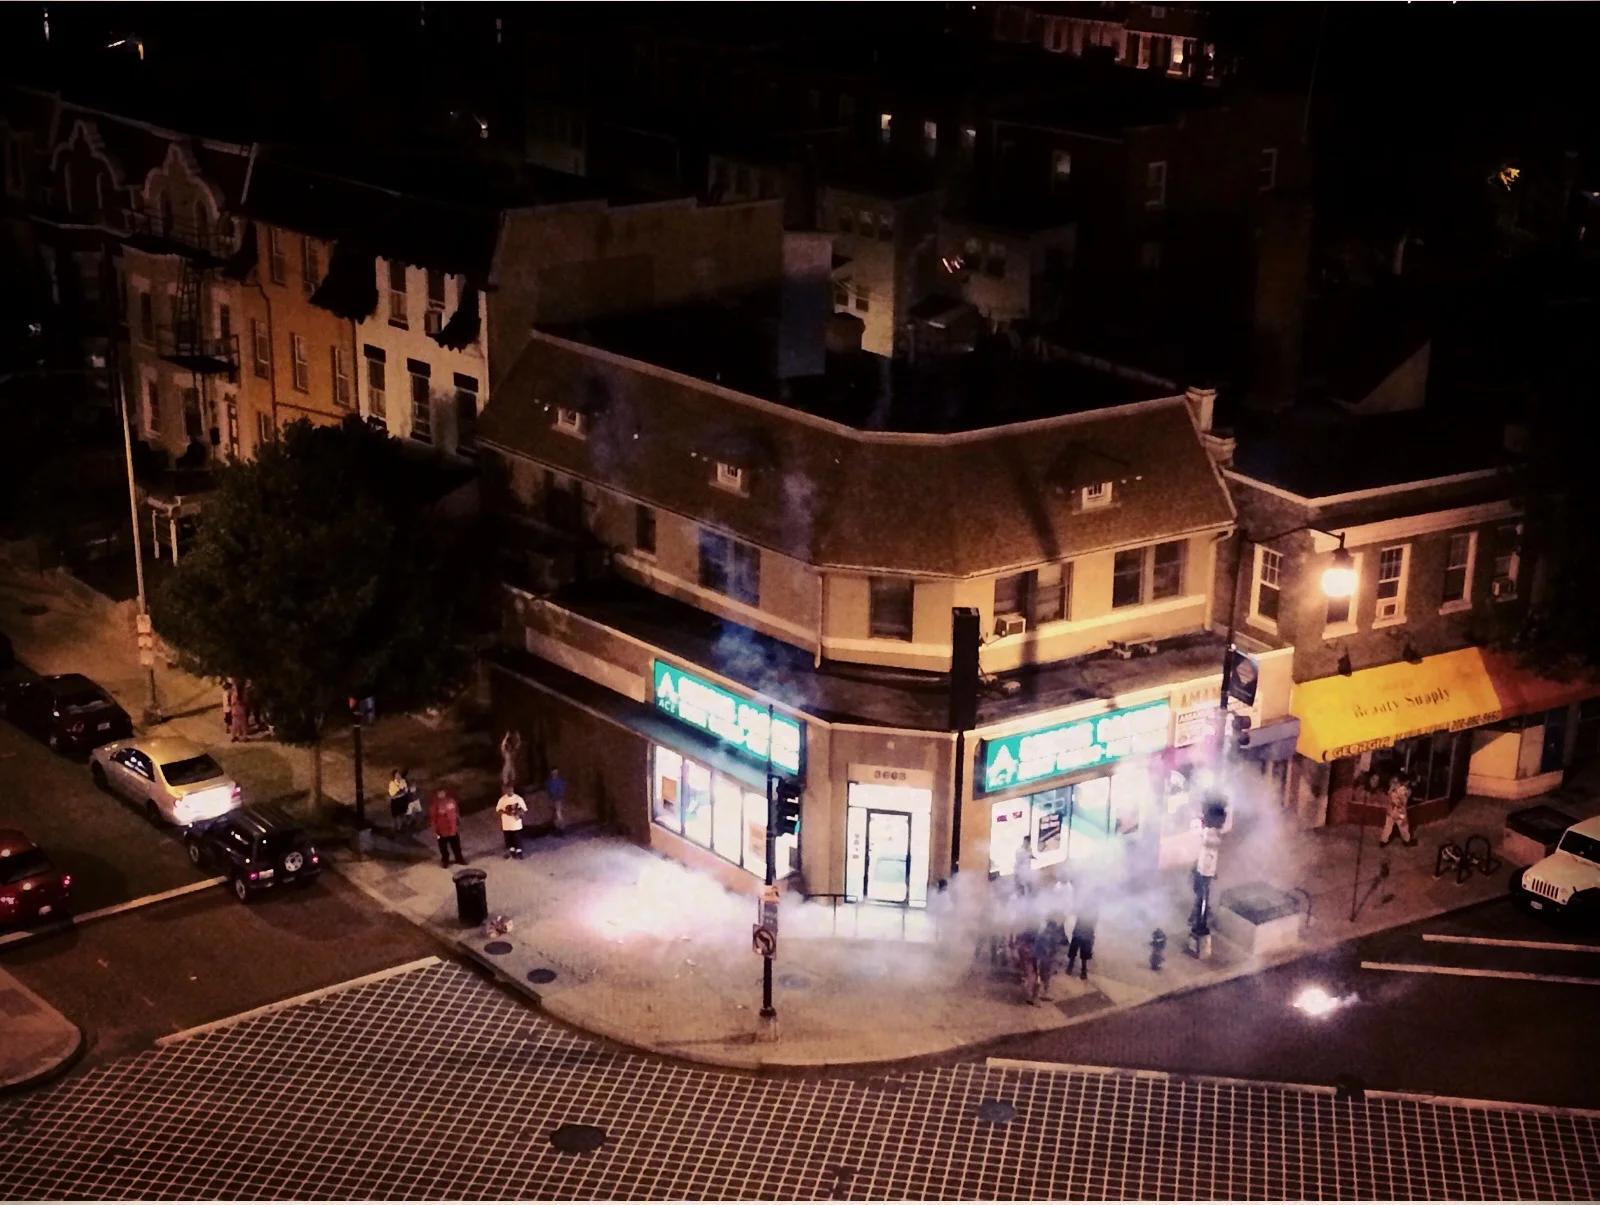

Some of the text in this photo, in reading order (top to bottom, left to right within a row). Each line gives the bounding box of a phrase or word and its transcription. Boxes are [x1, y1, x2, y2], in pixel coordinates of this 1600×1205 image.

[658, 699, 675, 714] ACE
[1405, 687, 1450, 708] Supply
[1333, 736, 1392, 758] GEORGIA
